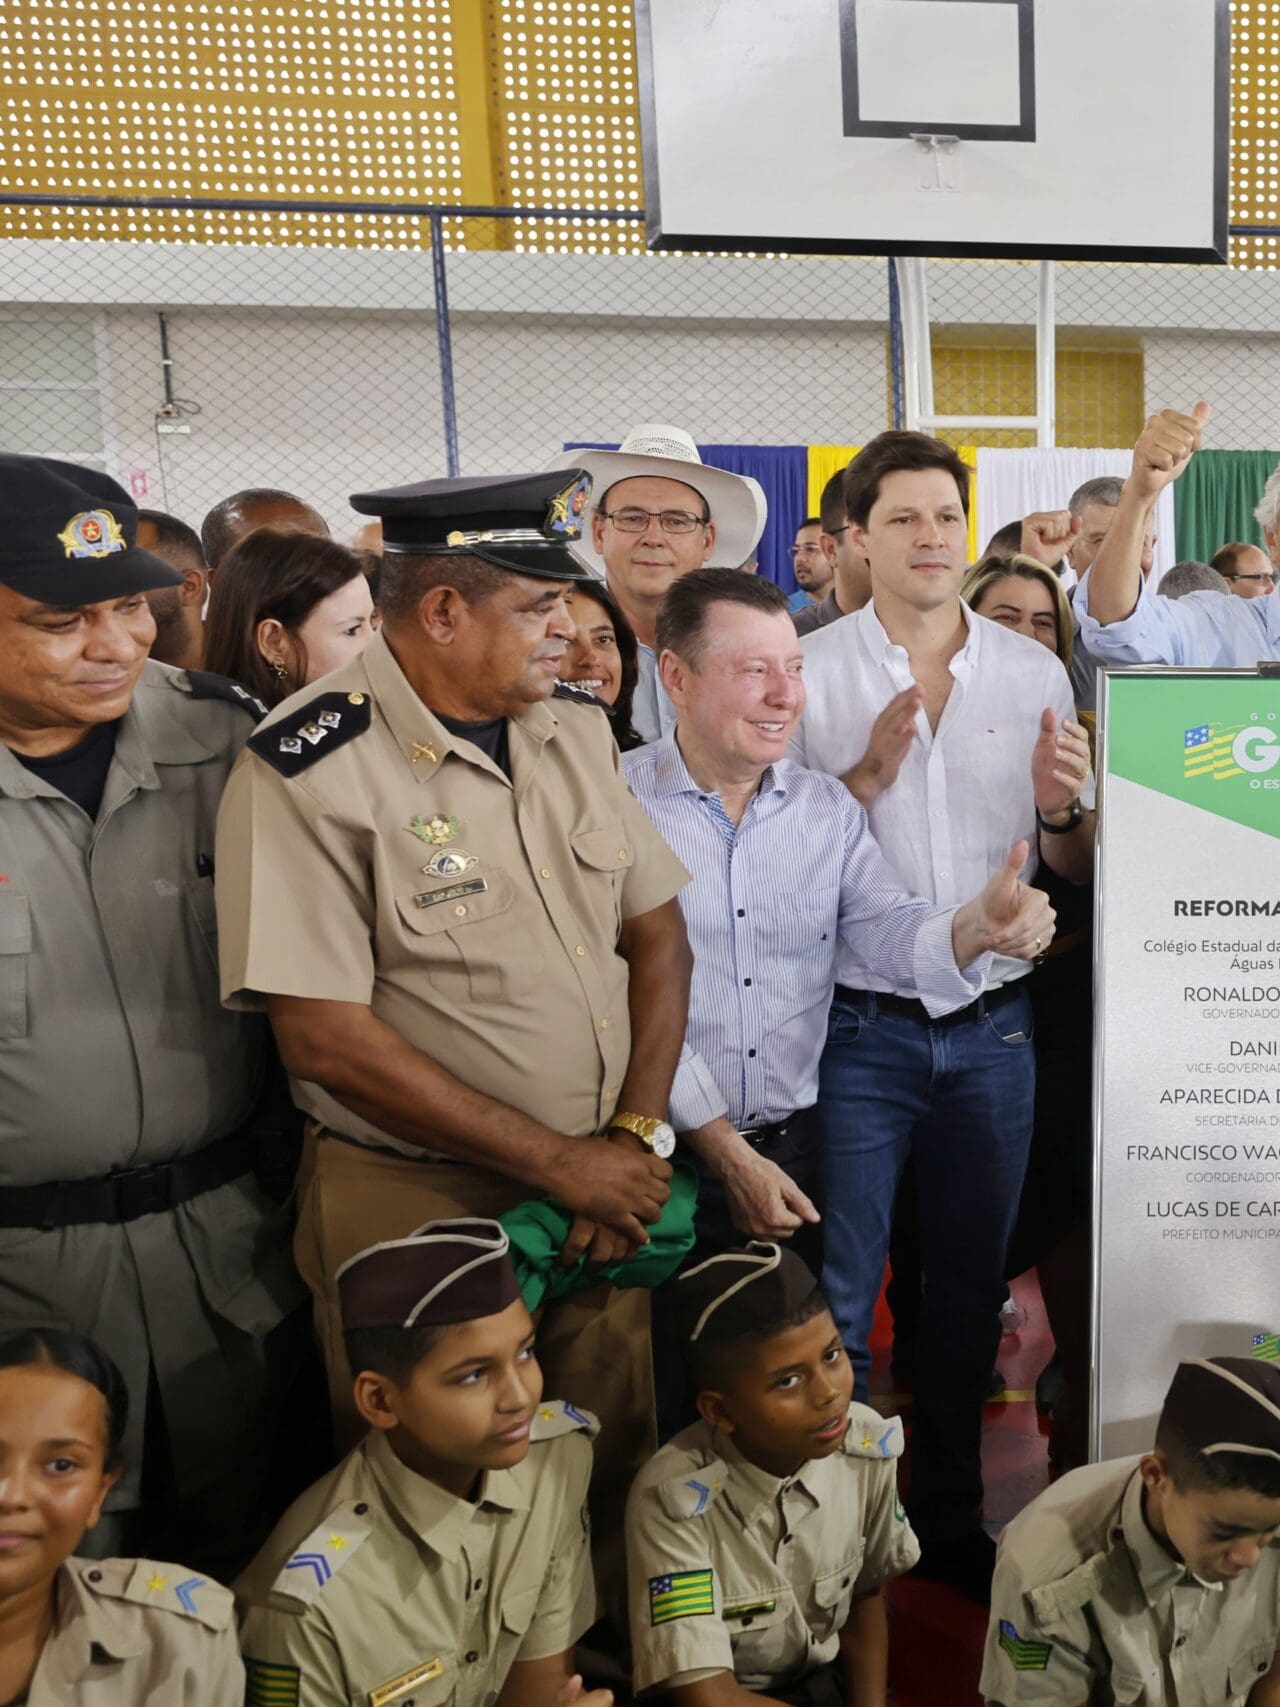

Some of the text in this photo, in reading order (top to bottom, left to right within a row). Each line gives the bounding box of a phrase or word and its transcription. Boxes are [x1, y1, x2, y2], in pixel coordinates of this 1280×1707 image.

[1250, 779, 1260, 789] O
[1144, 939, 1197, 955] Colégio
[1201, 939, 1262, 953] Estadual
[1230, 955, 1274, 973] Águas
[1184, 986, 1280, 1002] RONALDO
[1160, 1088, 1270, 1104] APARECIDA
[1195, 1113, 1266, 1126] SECRETÁRIA
[1127, 1144, 1237, 1161] FRANCISCO
[1147, 1201, 1209, 1218] LUCAS
[1215, 1201, 1241, 1218] DE
[1163, 1228, 1219, 1240] PREFEITO
